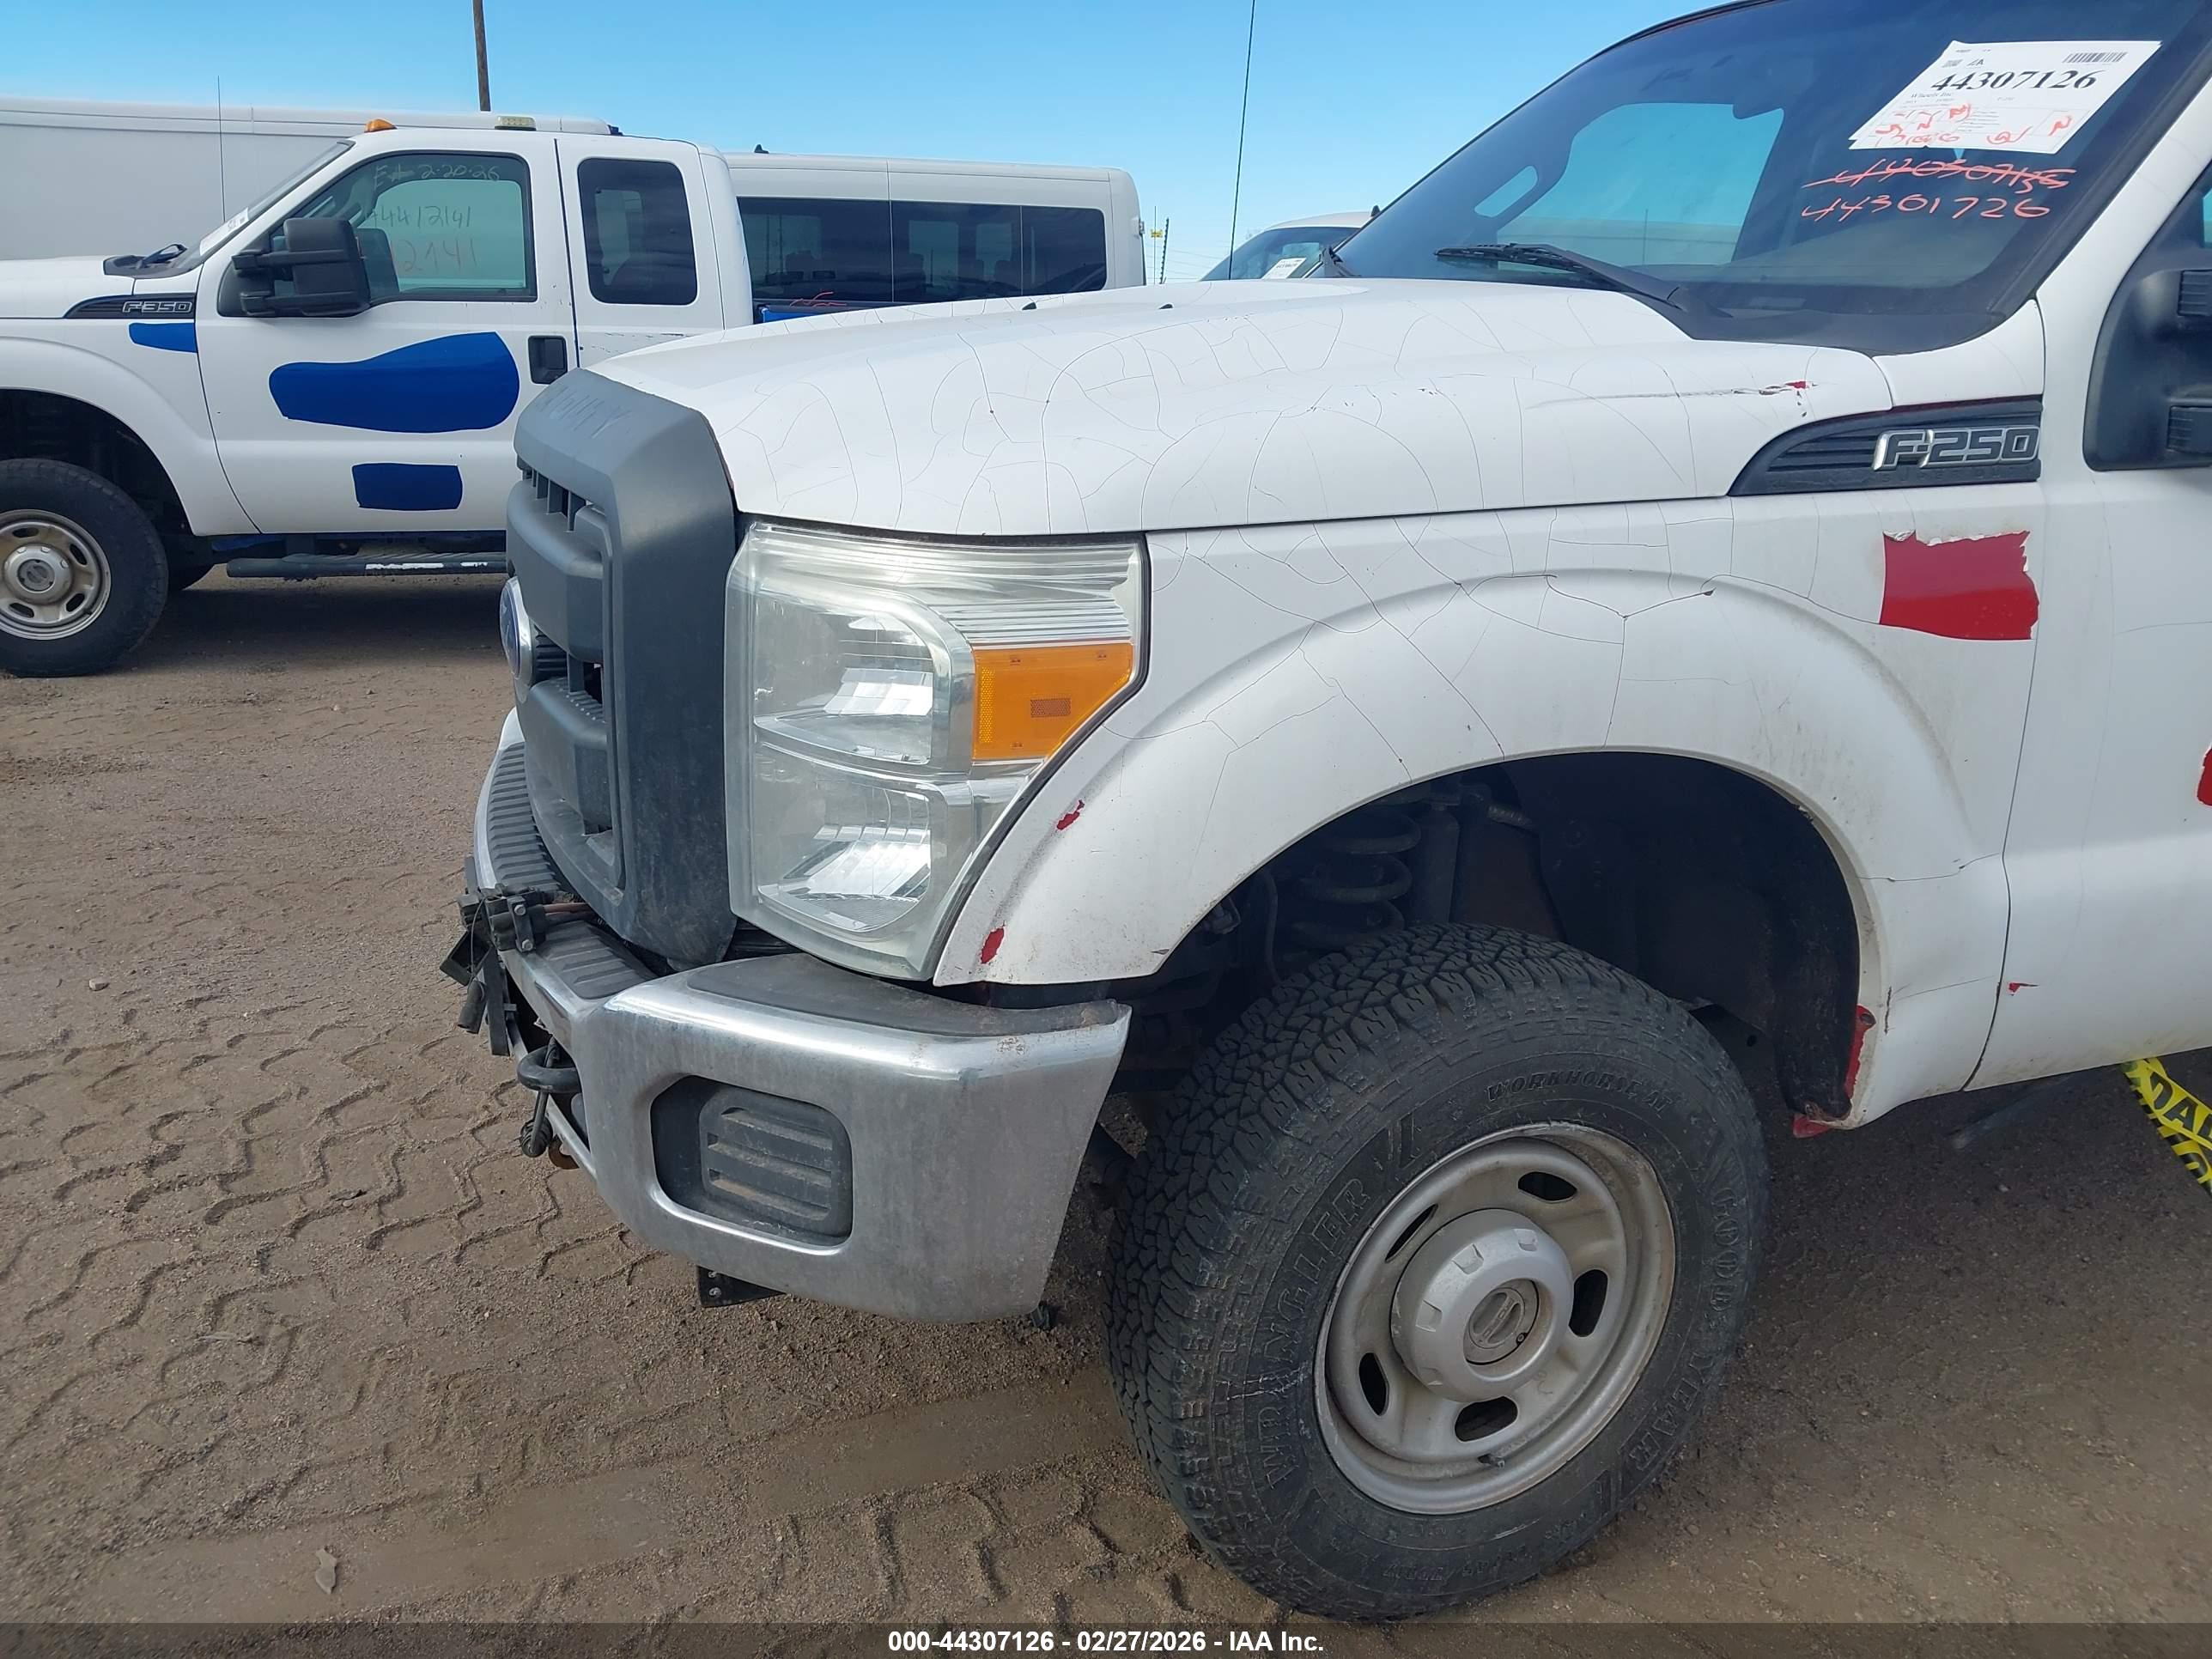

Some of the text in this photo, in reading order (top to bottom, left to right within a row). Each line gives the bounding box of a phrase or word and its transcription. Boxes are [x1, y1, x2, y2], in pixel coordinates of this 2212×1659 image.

[1930, 70, 2106, 91] 44307126
[1484, 1070, 1644, 1103] WORKHORSE
[1256, 1177, 1371, 1490] WRANGLER
